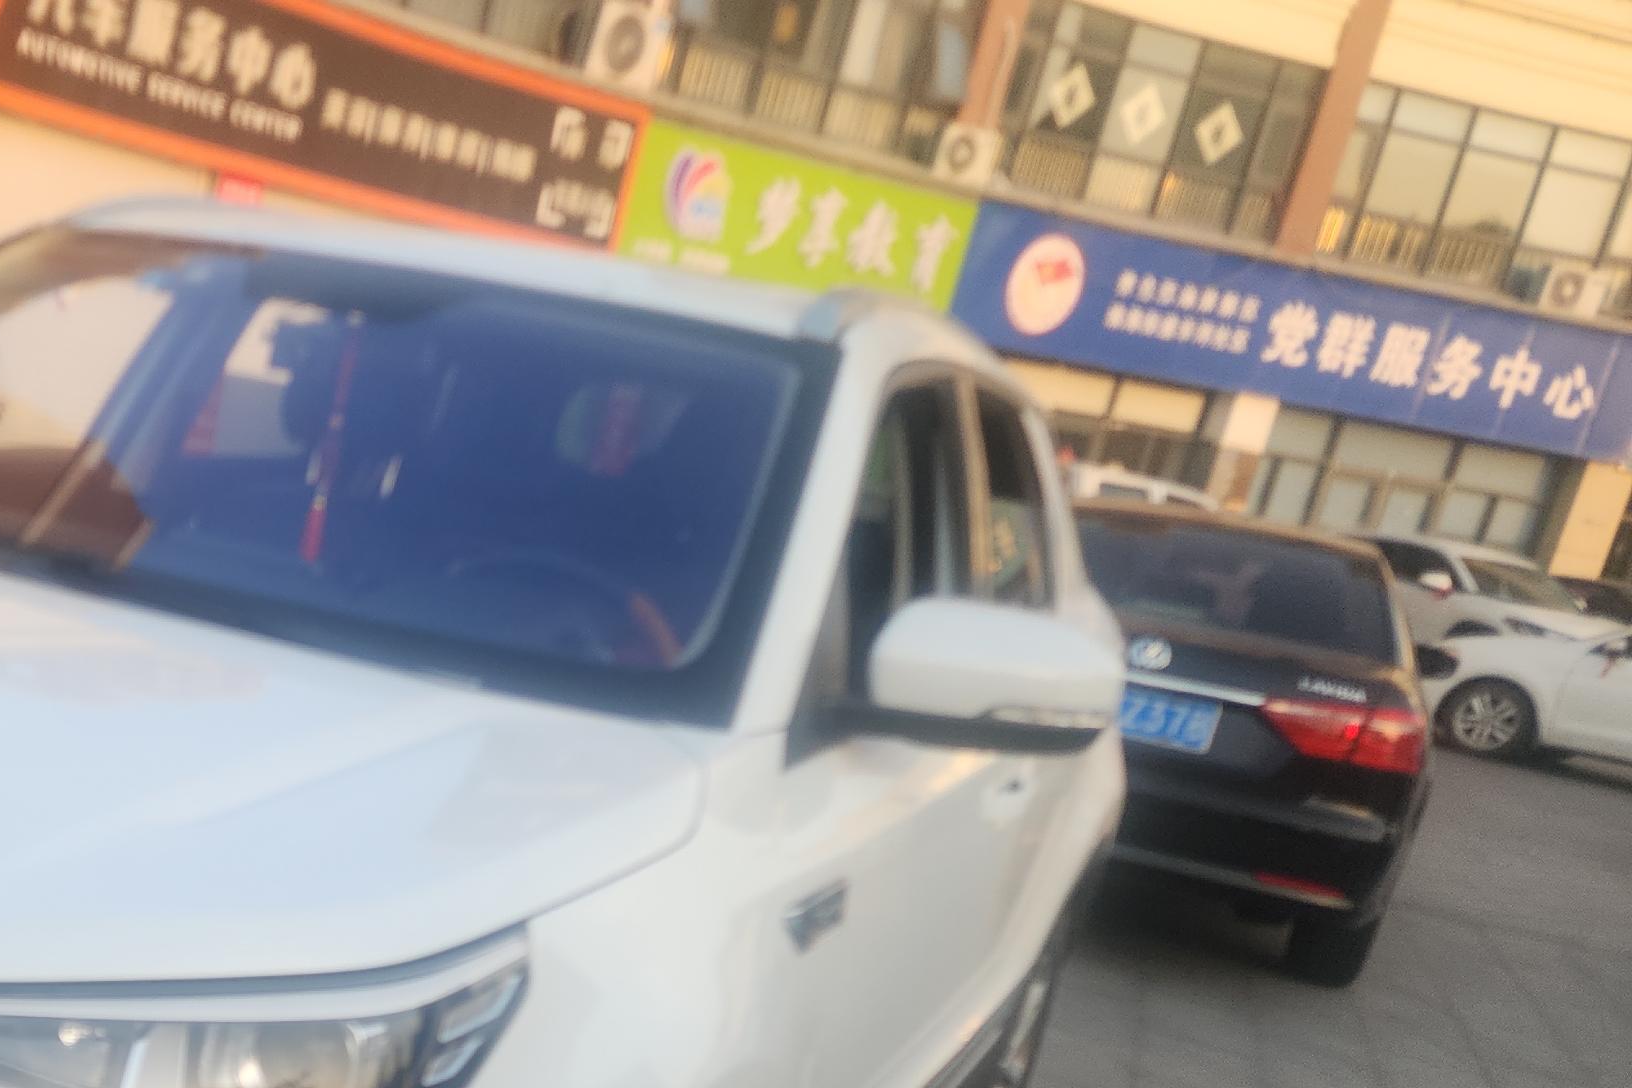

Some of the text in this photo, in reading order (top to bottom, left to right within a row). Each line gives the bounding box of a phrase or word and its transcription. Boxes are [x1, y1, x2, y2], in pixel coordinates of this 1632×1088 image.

[16, 26, 145, 96] AUTOMOTIVE
[146, 70, 228, 121] SERVICE
[229, 98, 304, 143] CENTER
[1261, 300, 1595, 421] 党群服务中心
